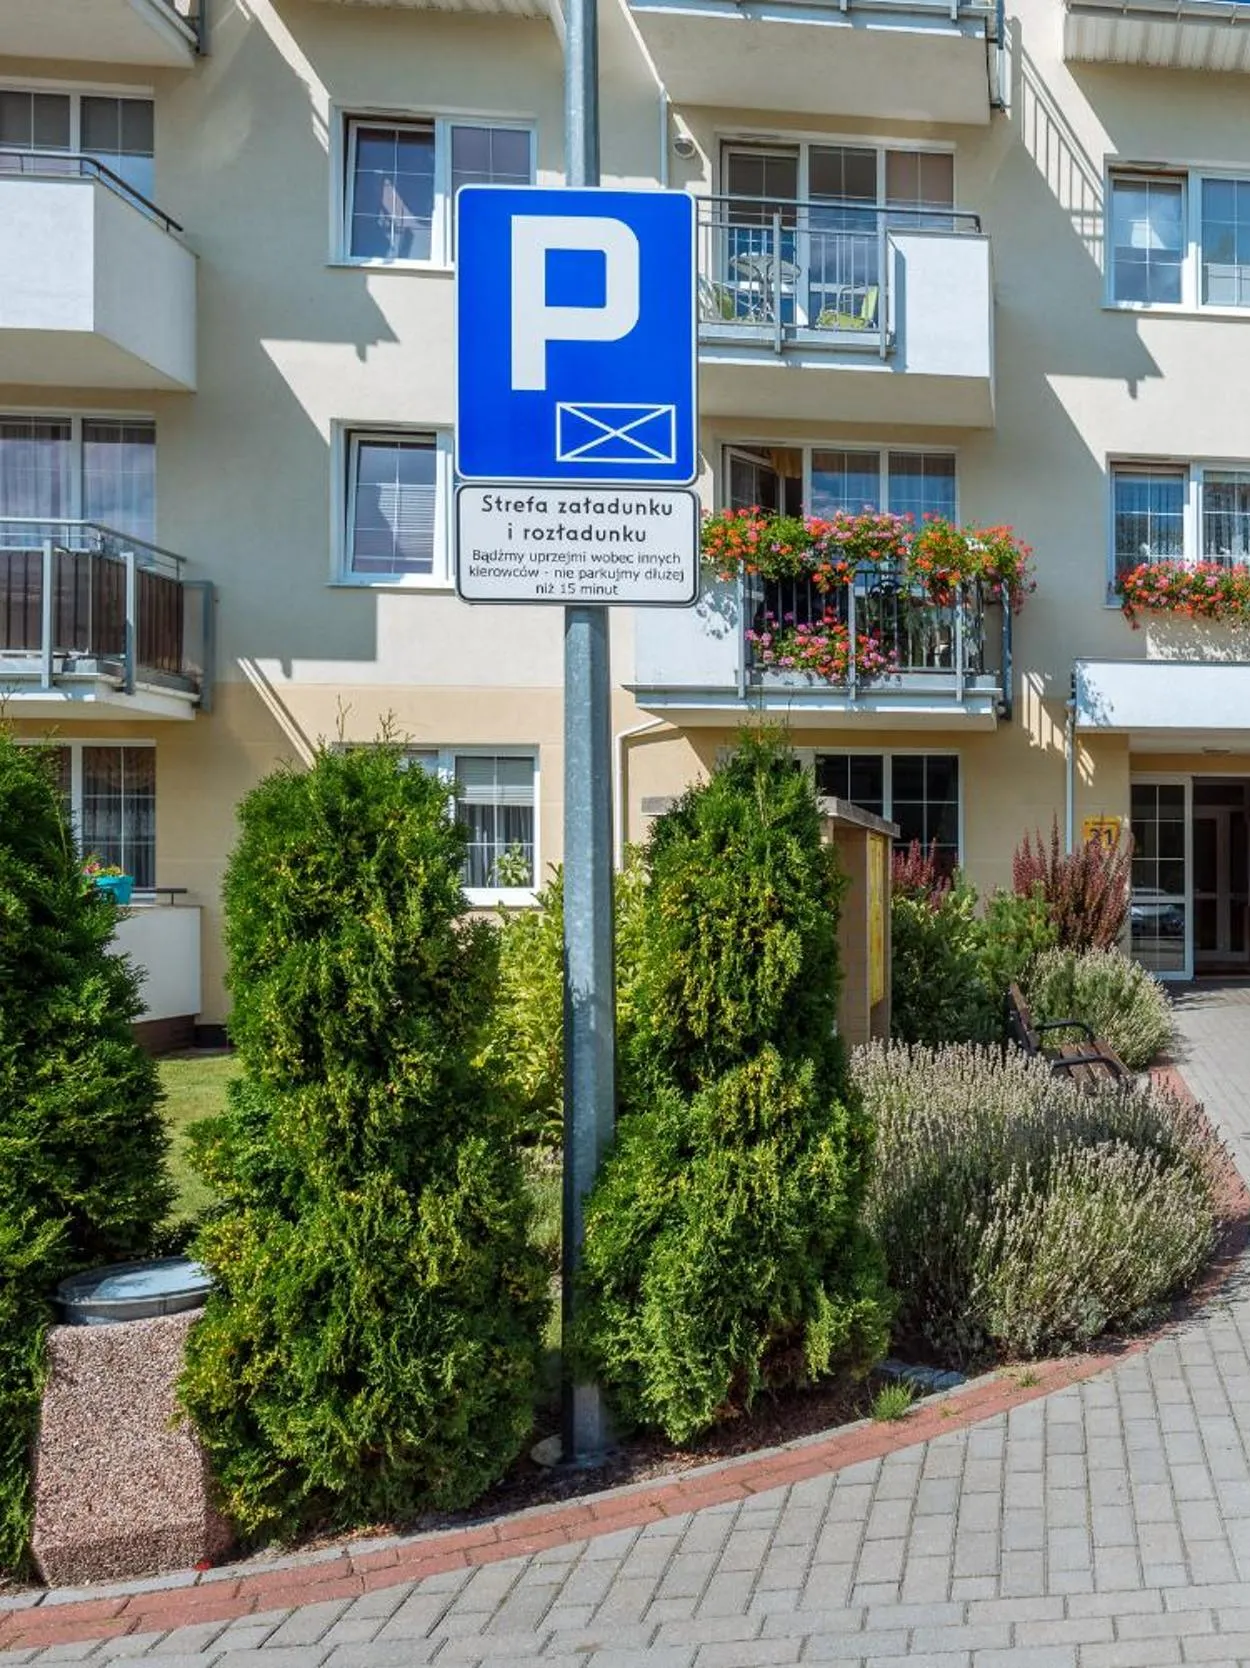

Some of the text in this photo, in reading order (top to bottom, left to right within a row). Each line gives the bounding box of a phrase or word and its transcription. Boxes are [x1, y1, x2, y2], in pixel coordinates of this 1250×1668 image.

[511, 214, 640, 391] P
[481, 494, 673, 516] Strefa załadunku
[507, 522, 646, 542] i rozładunku
[529, 551, 586, 565] uprzejmi
[591, 551, 634, 564] wobec
[637, 552, 681, 566] innych
[554, 567, 575, 579] nie
[578, 568, 641, 582] parkujmy
[535, 582, 618, 595] niż 15 minut
